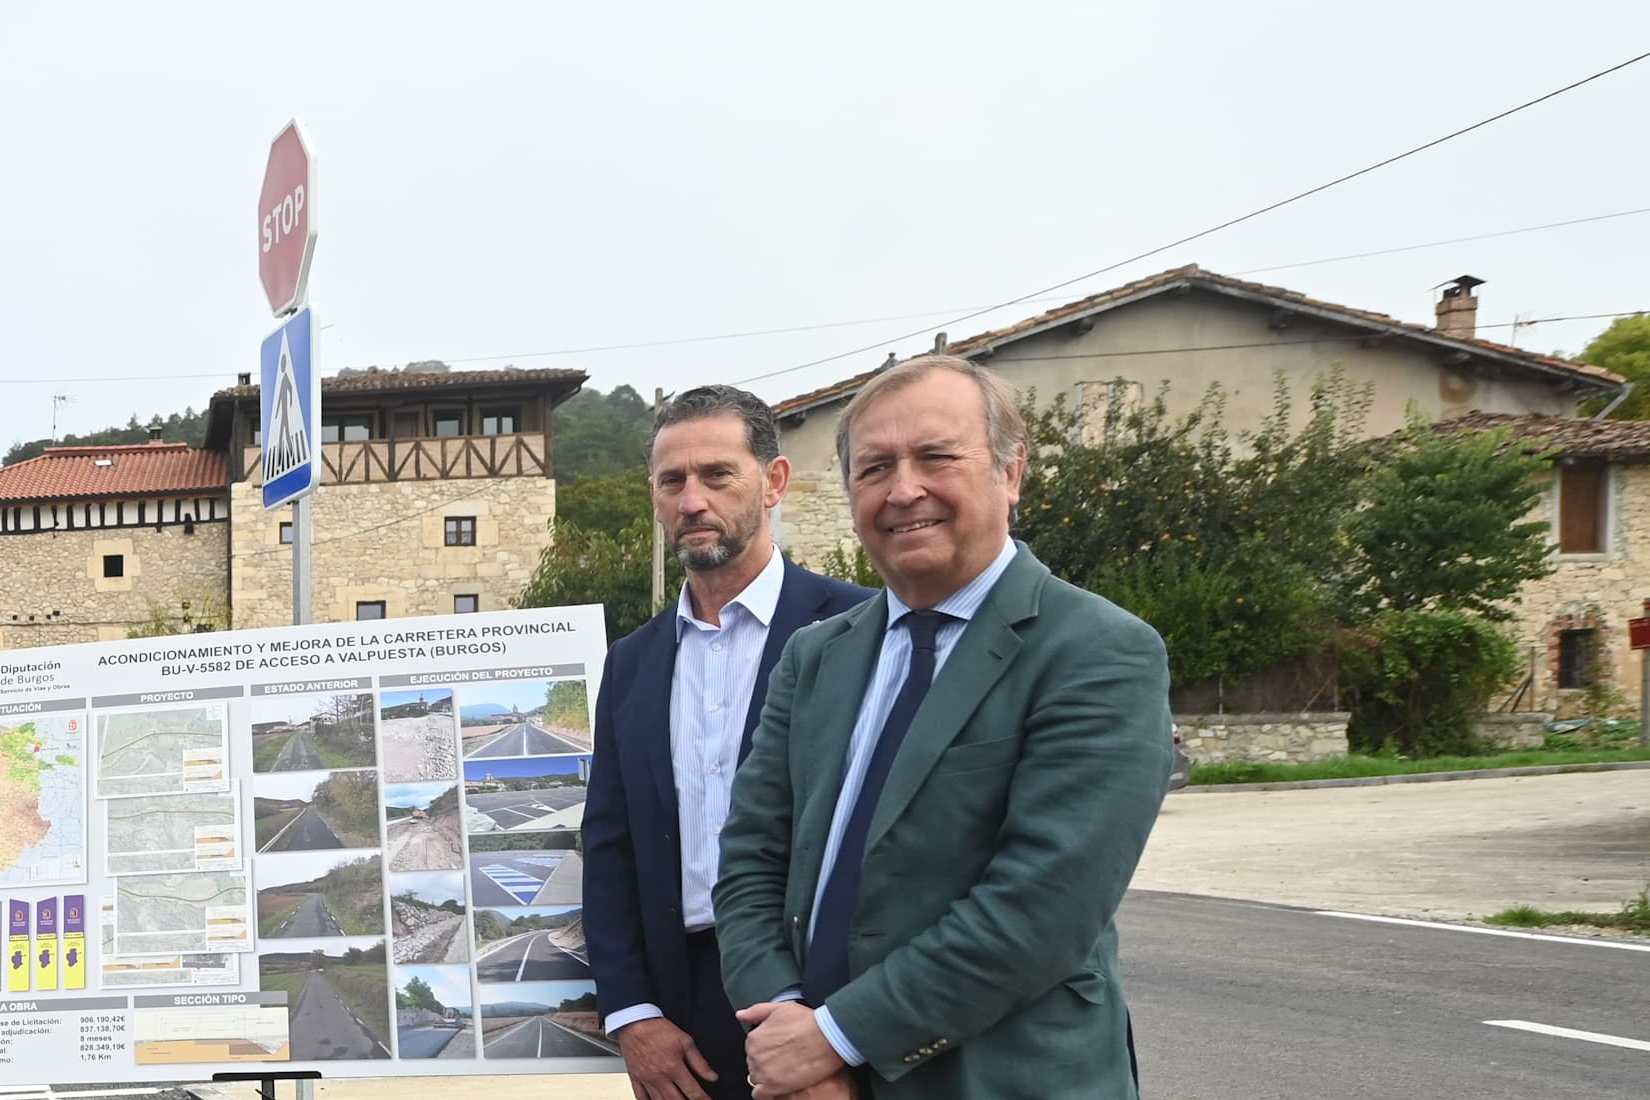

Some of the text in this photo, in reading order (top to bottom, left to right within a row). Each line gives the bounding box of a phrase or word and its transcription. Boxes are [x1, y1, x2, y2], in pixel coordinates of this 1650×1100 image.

[263, 184, 304, 253] STOP
[98, 621, 576, 666] ACONDICIONAMIENTO Y MEJORA DE LA CARRETERA PROVINCIAL
[161, 641, 506, 676] BU-V-5582 DE ACCESO A VALPUESTA (BURGOS)
[0, 661, 61, 675] Diputación
[0, 673, 55, 686] de Burgos
[410, 667, 553, 685] EJECUCIÓN DEL PROYECTO
[264, 679, 358, 694] ESTADO ANTERIOR
[140, 691, 194, 703] PROYECTO
[9, 1002, 38, 1011] OBRA
[174, 994, 246, 1006] SECCIÓN TIPO
[22, 1017, 62, 1026] Licitación:
[80, 1015, 125, 1024] 906.190,42€
[1, 1028, 52, 1037] adjudicación:
[80, 1053, 96, 1062] 1,76
[98, 1053, 112, 1061] Km
